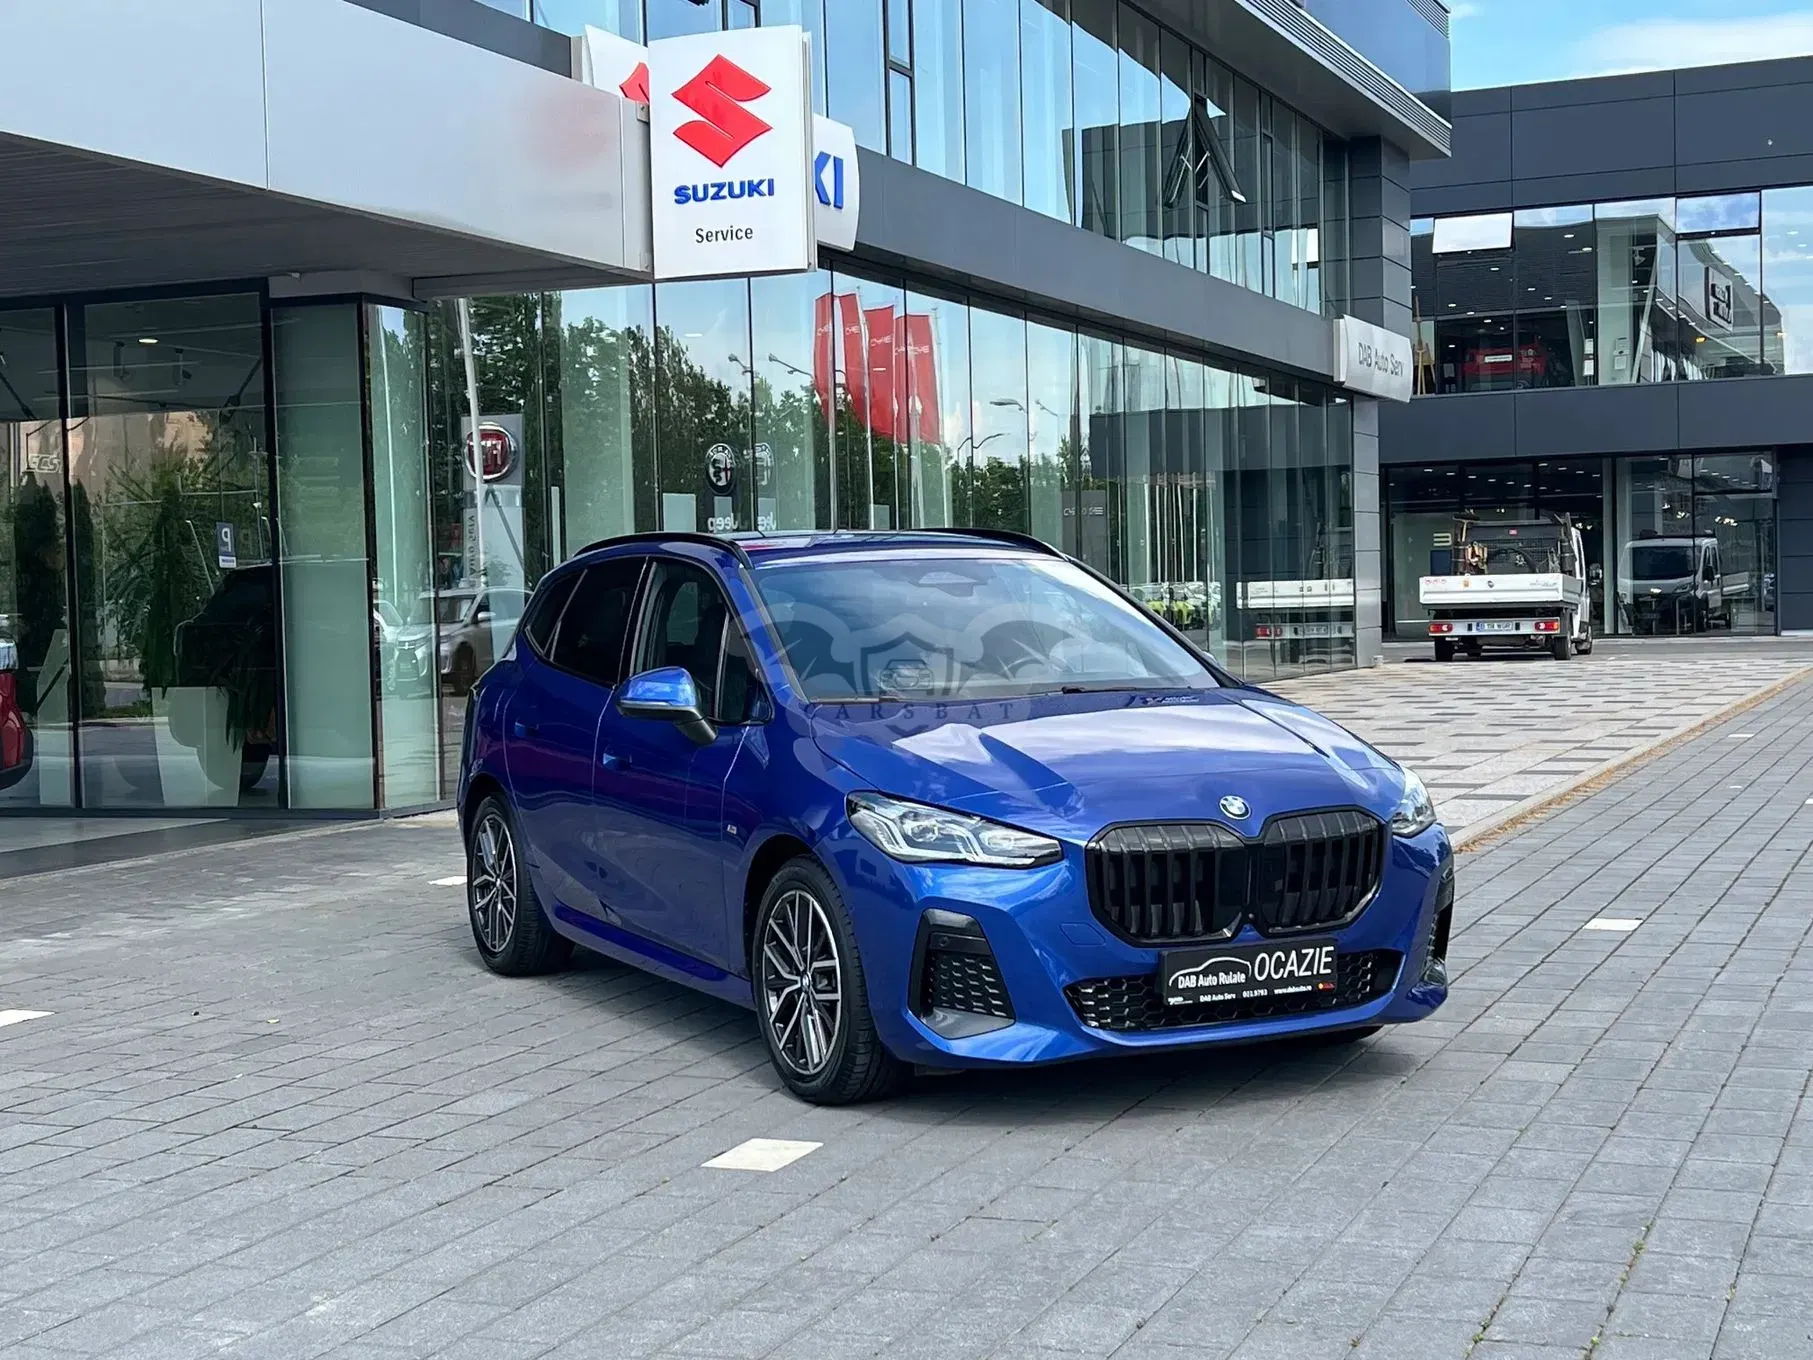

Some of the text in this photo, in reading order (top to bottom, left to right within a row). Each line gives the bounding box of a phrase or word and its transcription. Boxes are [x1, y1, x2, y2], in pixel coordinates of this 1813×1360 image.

[674, 178, 774, 204] SUZUKI
[695, 225, 753, 243] Service
[1358, 342, 1403, 377] DAB Auto Serv
[1254, 946, 1335, 981] OCAZIE
[1178, 971, 1246, 989] DAB Auto Rulate
